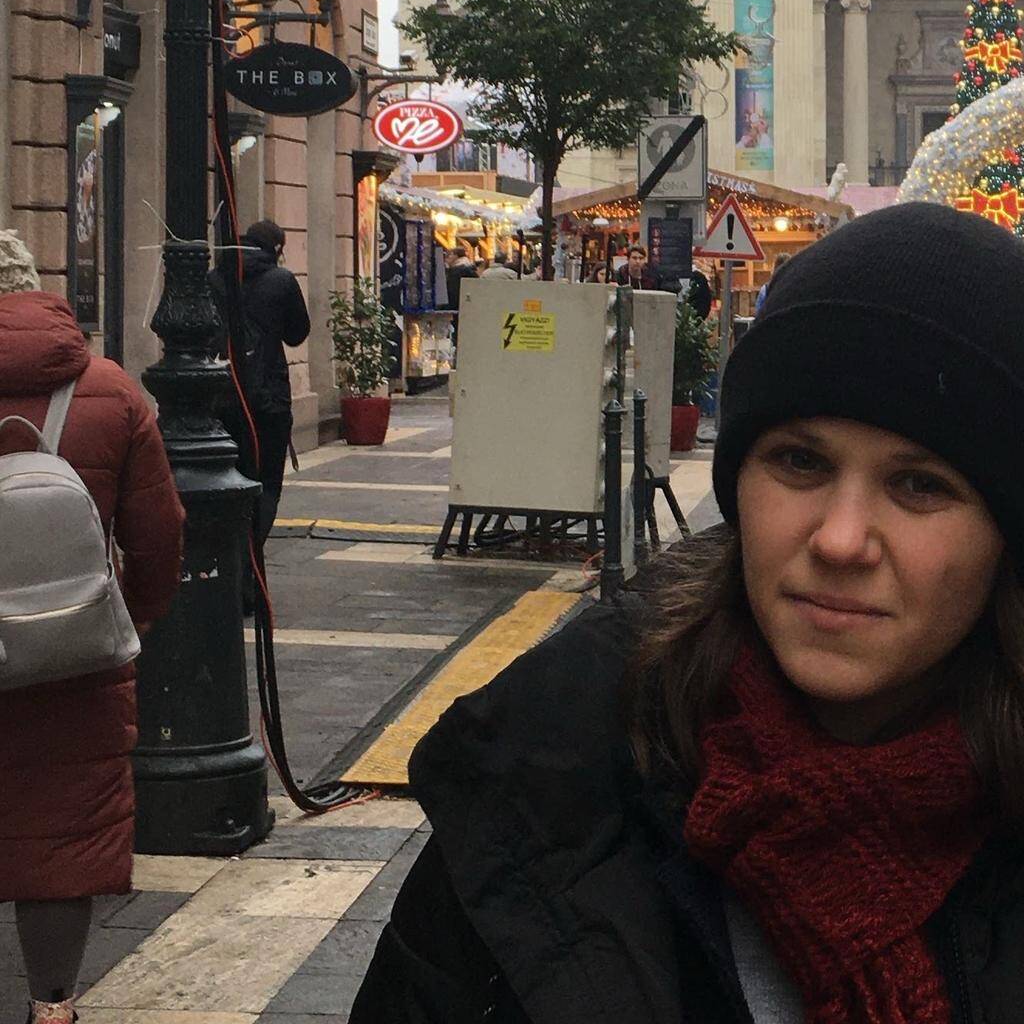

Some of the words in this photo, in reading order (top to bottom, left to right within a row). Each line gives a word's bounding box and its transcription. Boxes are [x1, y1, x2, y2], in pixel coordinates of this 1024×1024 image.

[236, 70, 279, 84] THE
[294, 70, 337, 85] BOX
[399, 107, 435, 118] PIZZA
